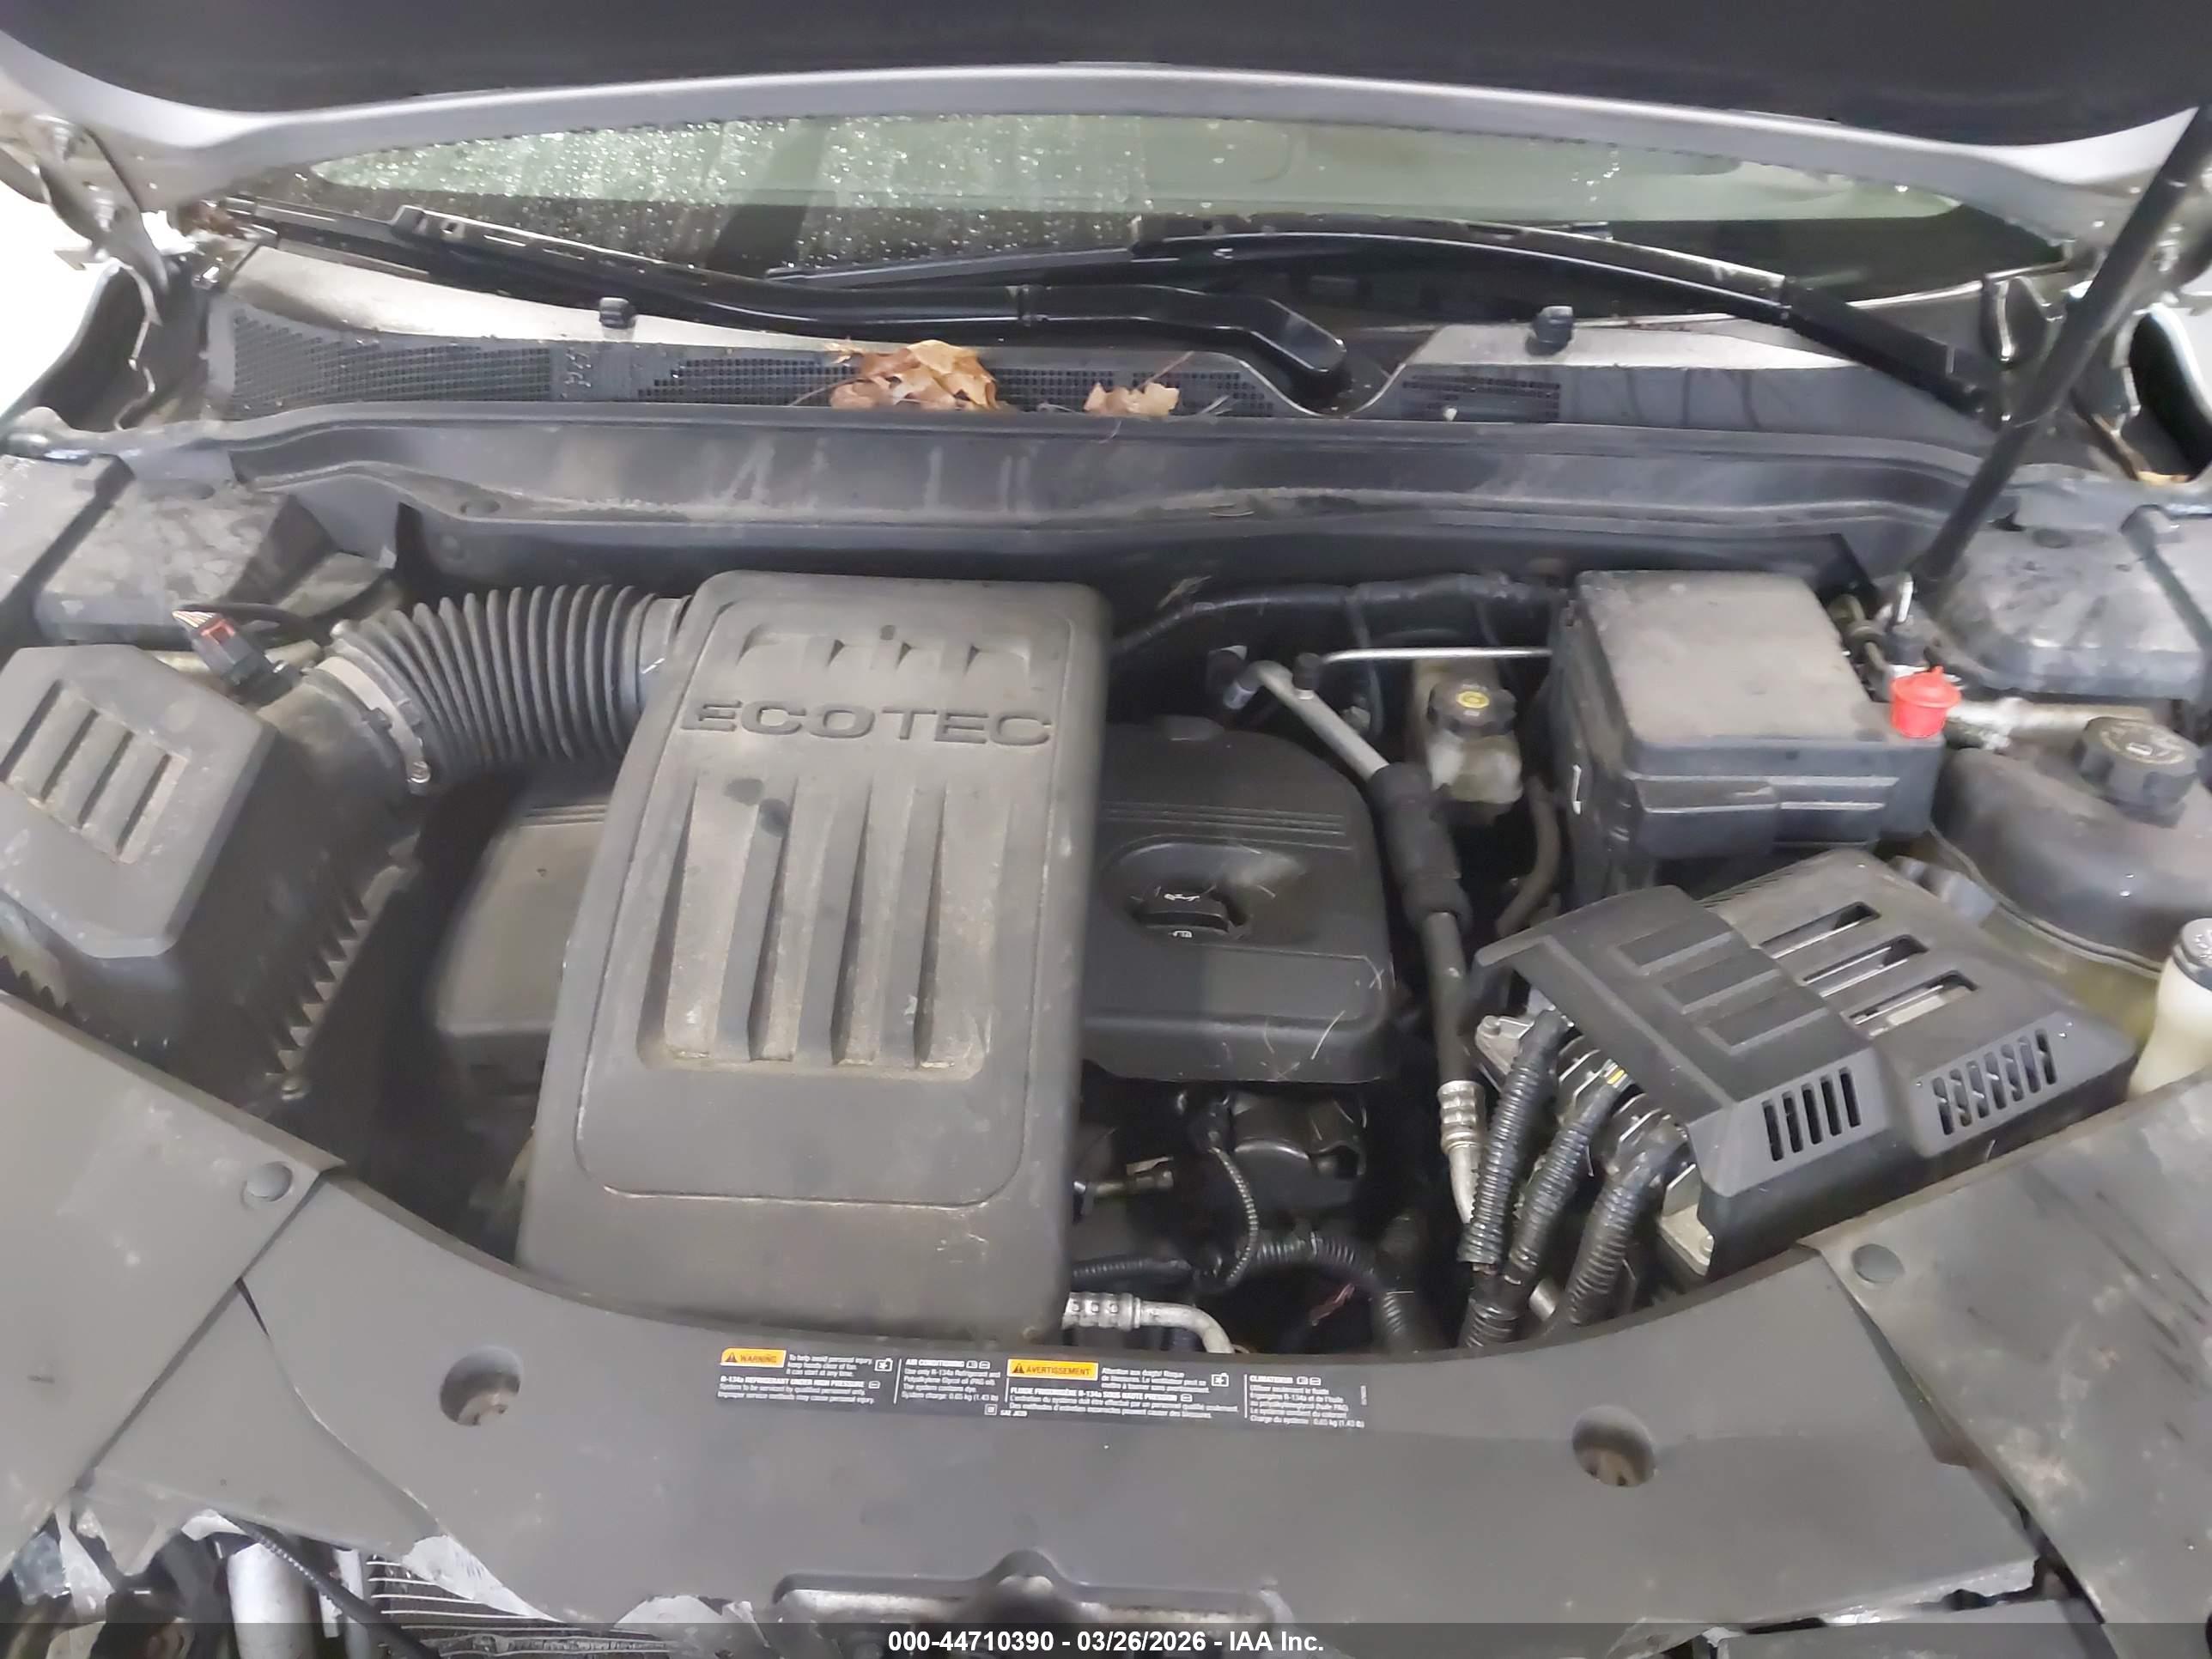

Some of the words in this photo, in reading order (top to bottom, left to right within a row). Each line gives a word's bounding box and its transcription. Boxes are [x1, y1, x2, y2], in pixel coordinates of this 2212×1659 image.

[680, 700, 1052, 746] ECOTEC
[740, 1353, 777, 1364] WARNING
[1026, 1365, 1091, 1376] AVERTISSEMENT
